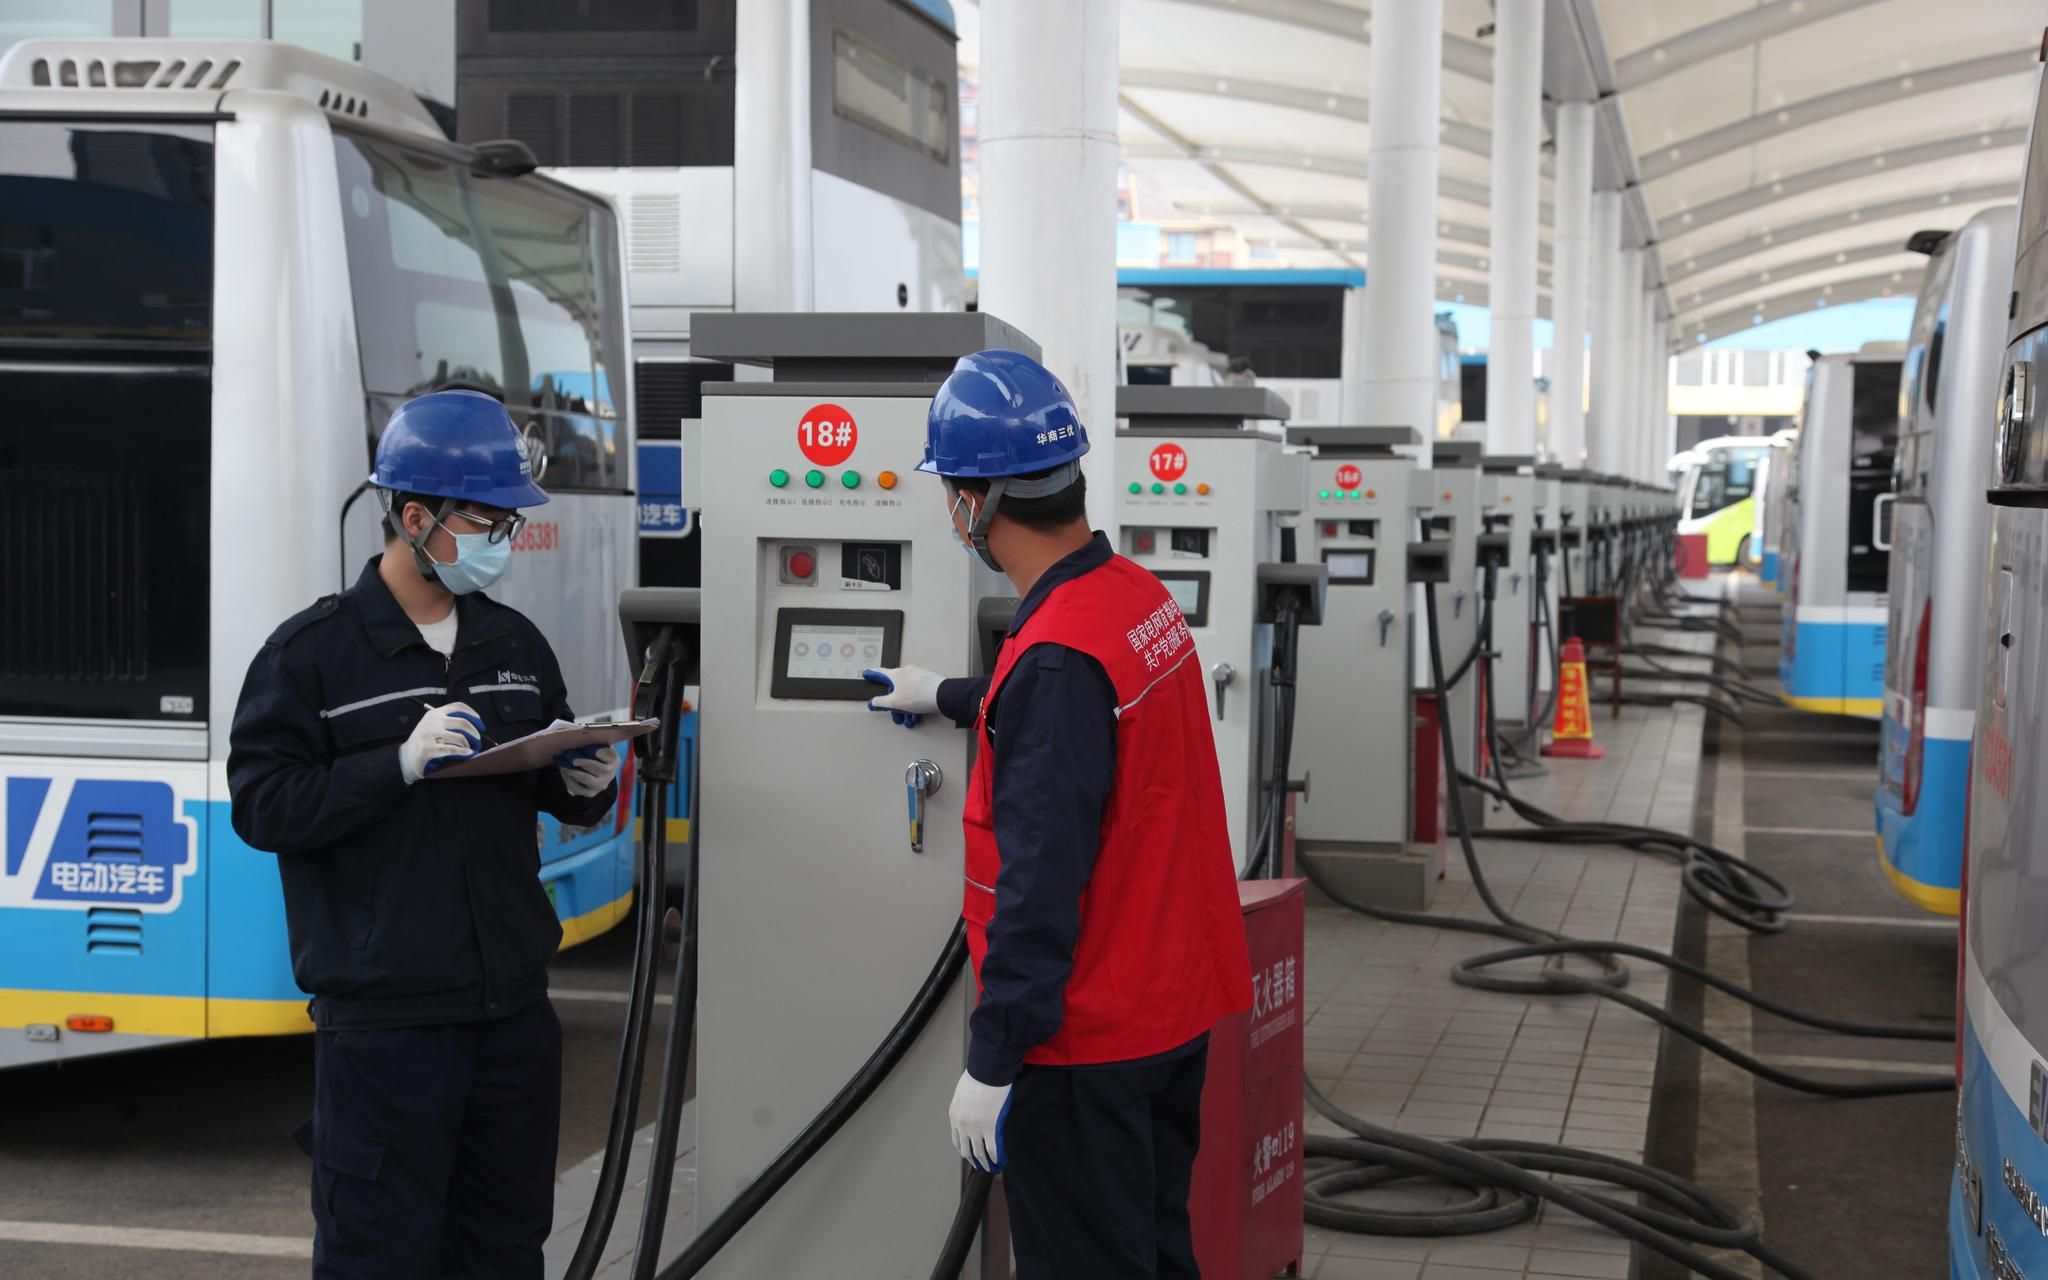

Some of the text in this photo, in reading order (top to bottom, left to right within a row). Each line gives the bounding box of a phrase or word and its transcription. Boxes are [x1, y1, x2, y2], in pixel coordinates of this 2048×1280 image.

[801, 421, 852, 447] 18#
[1036, 424, 1075, 446] 华商三优
[1152, 453, 1185, 471] 17#
[638, 503, 681, 526] 汽车
[51, 861, 165, 895] 电动汽车
[1250, 955, 1296, 1025] 灭火器箱
